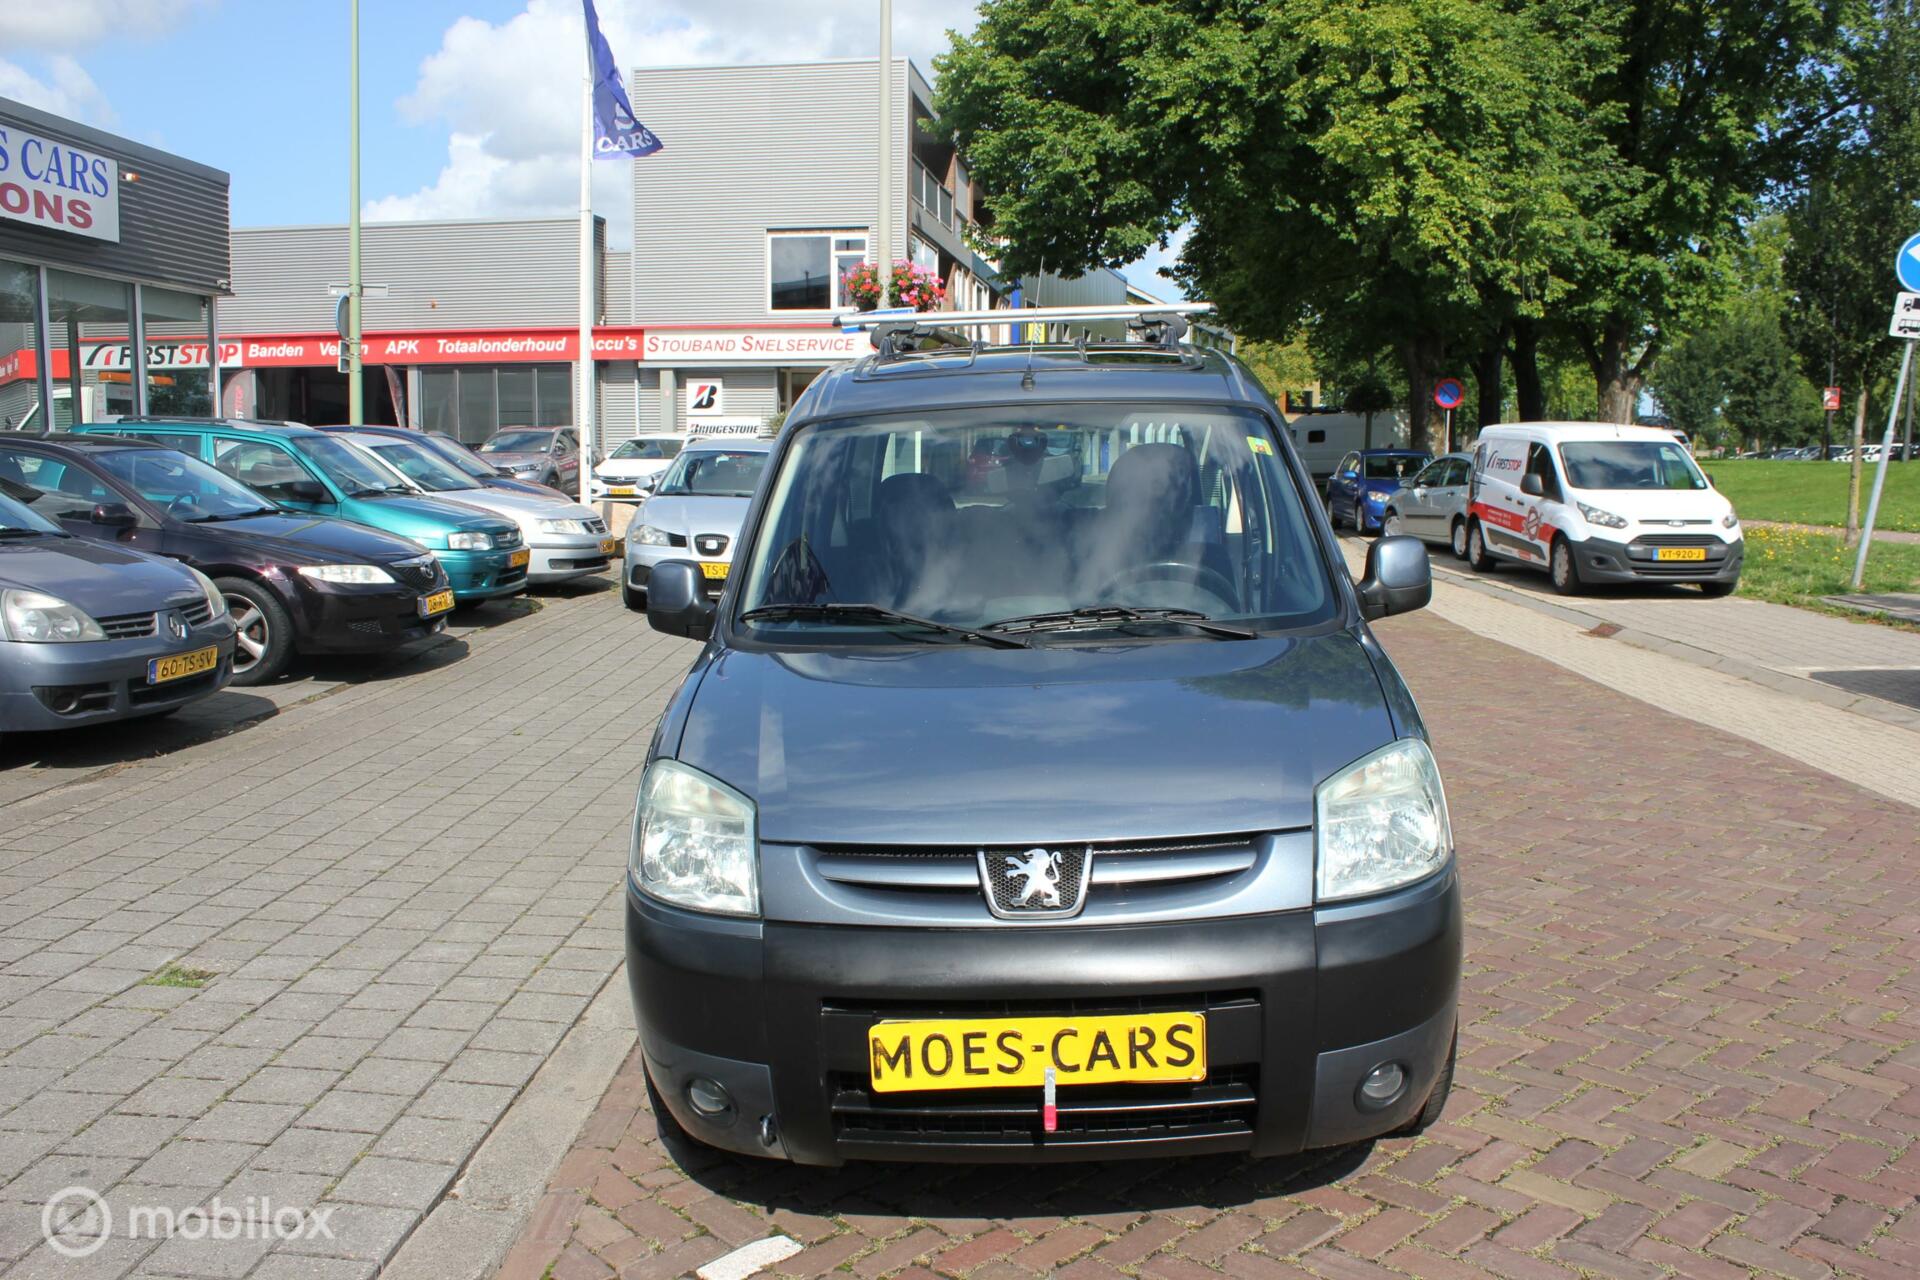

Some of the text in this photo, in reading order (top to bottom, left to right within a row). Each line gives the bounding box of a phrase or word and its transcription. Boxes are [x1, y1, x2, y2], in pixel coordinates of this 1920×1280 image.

[597, 129, 653, 152] CARS
[21, 138, 109, 198] CARS
[248, 343, 304, 358] Banden
[385, 339, 419, 354] APK
[437, 337, 567, 353] Totaalonderhoud
[647, 335, 855, 352] STOUBAND SNELSERVICE
[690, 424, 760, 433] BRIDGESTONE
[1660, 550, 1702, 559] VT-920-J
[161, 650, 214, 677] 60-TS-SV
[872, 1023, 1196, 1080] MOES-CARS
